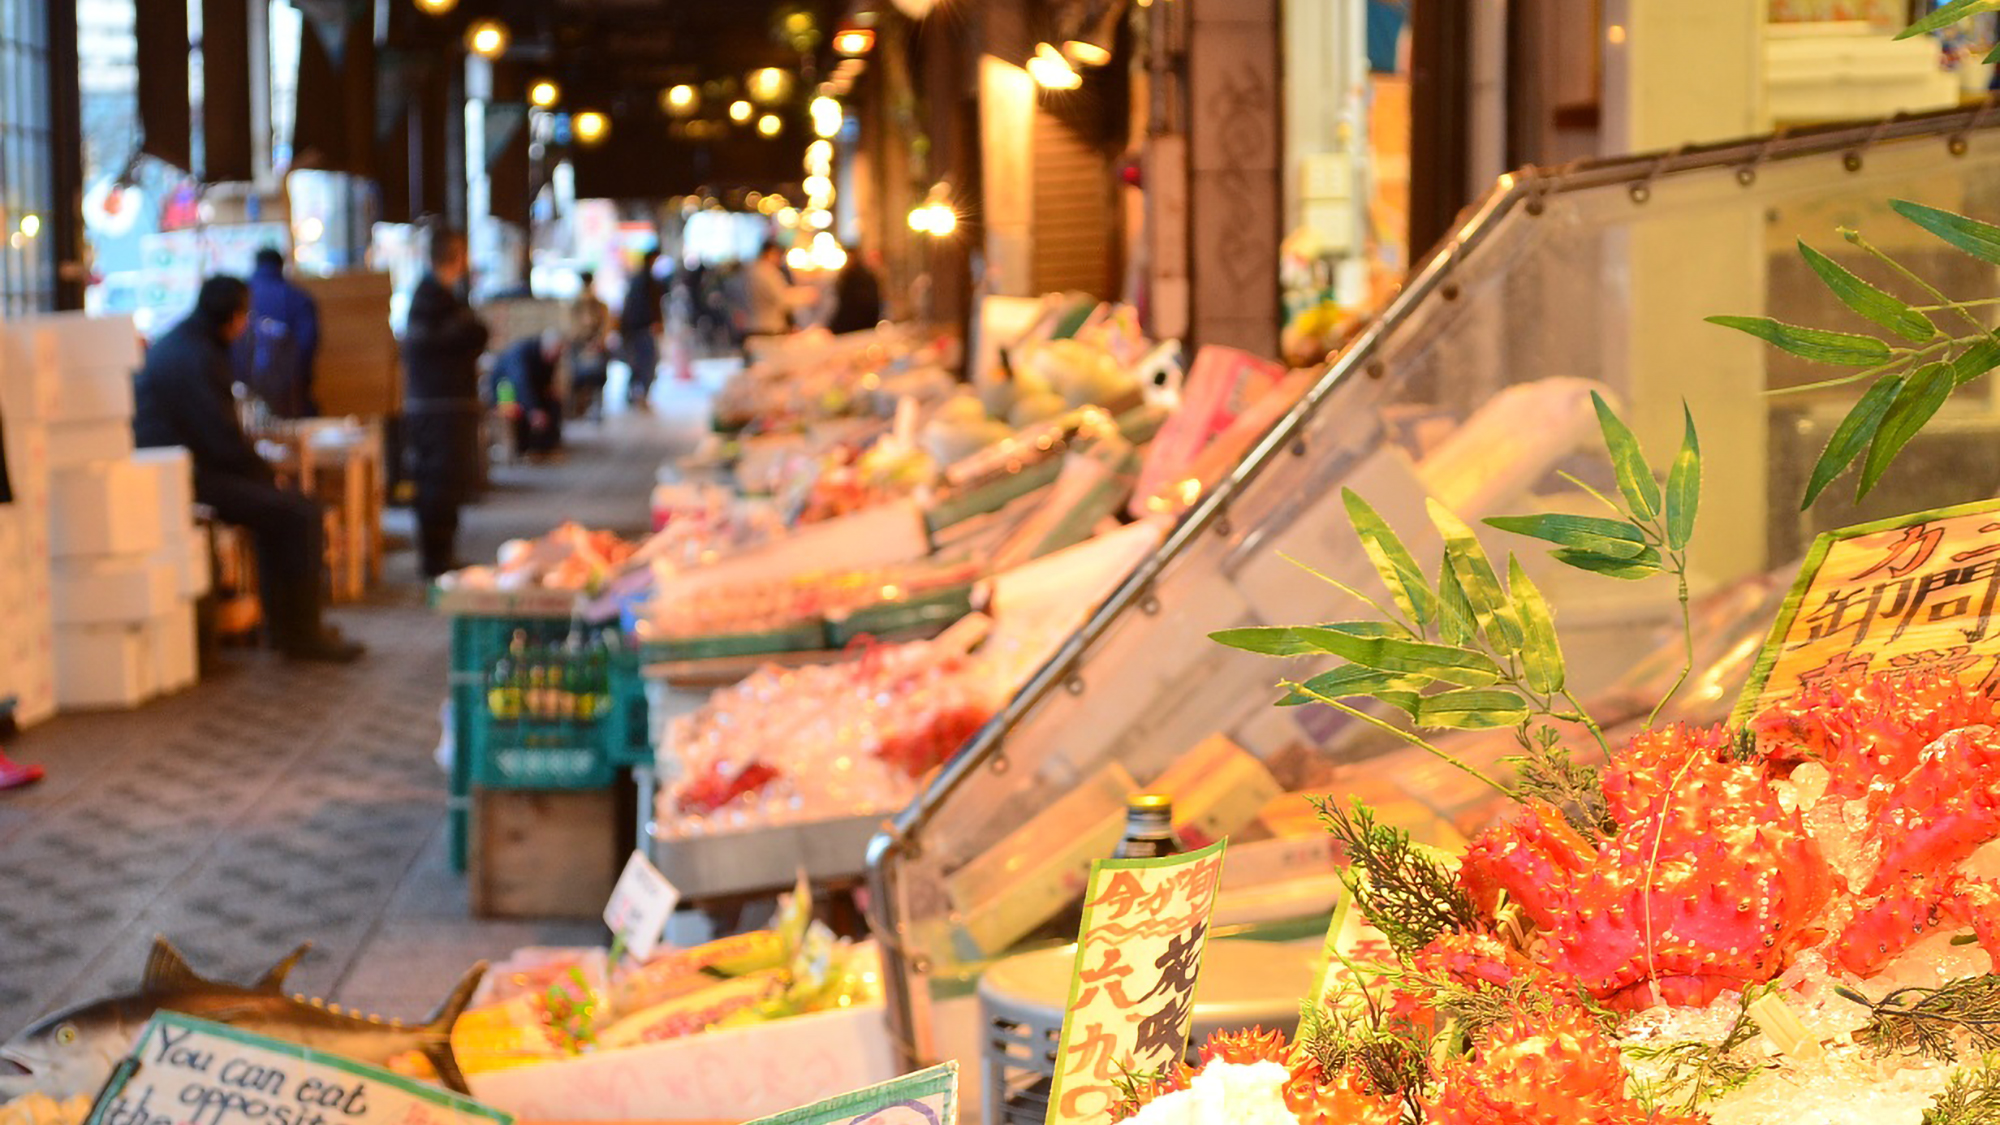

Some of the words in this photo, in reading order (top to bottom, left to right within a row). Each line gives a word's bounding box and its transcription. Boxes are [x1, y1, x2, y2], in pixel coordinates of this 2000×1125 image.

[1787, 558, 2000, 652] 卸問
[155, 1023, 213, 1072] You
[219, 1056, 287, 1096] can
[297, 1077, 367, 1115] eat
[180, 1082, 340, 1125] opposi
